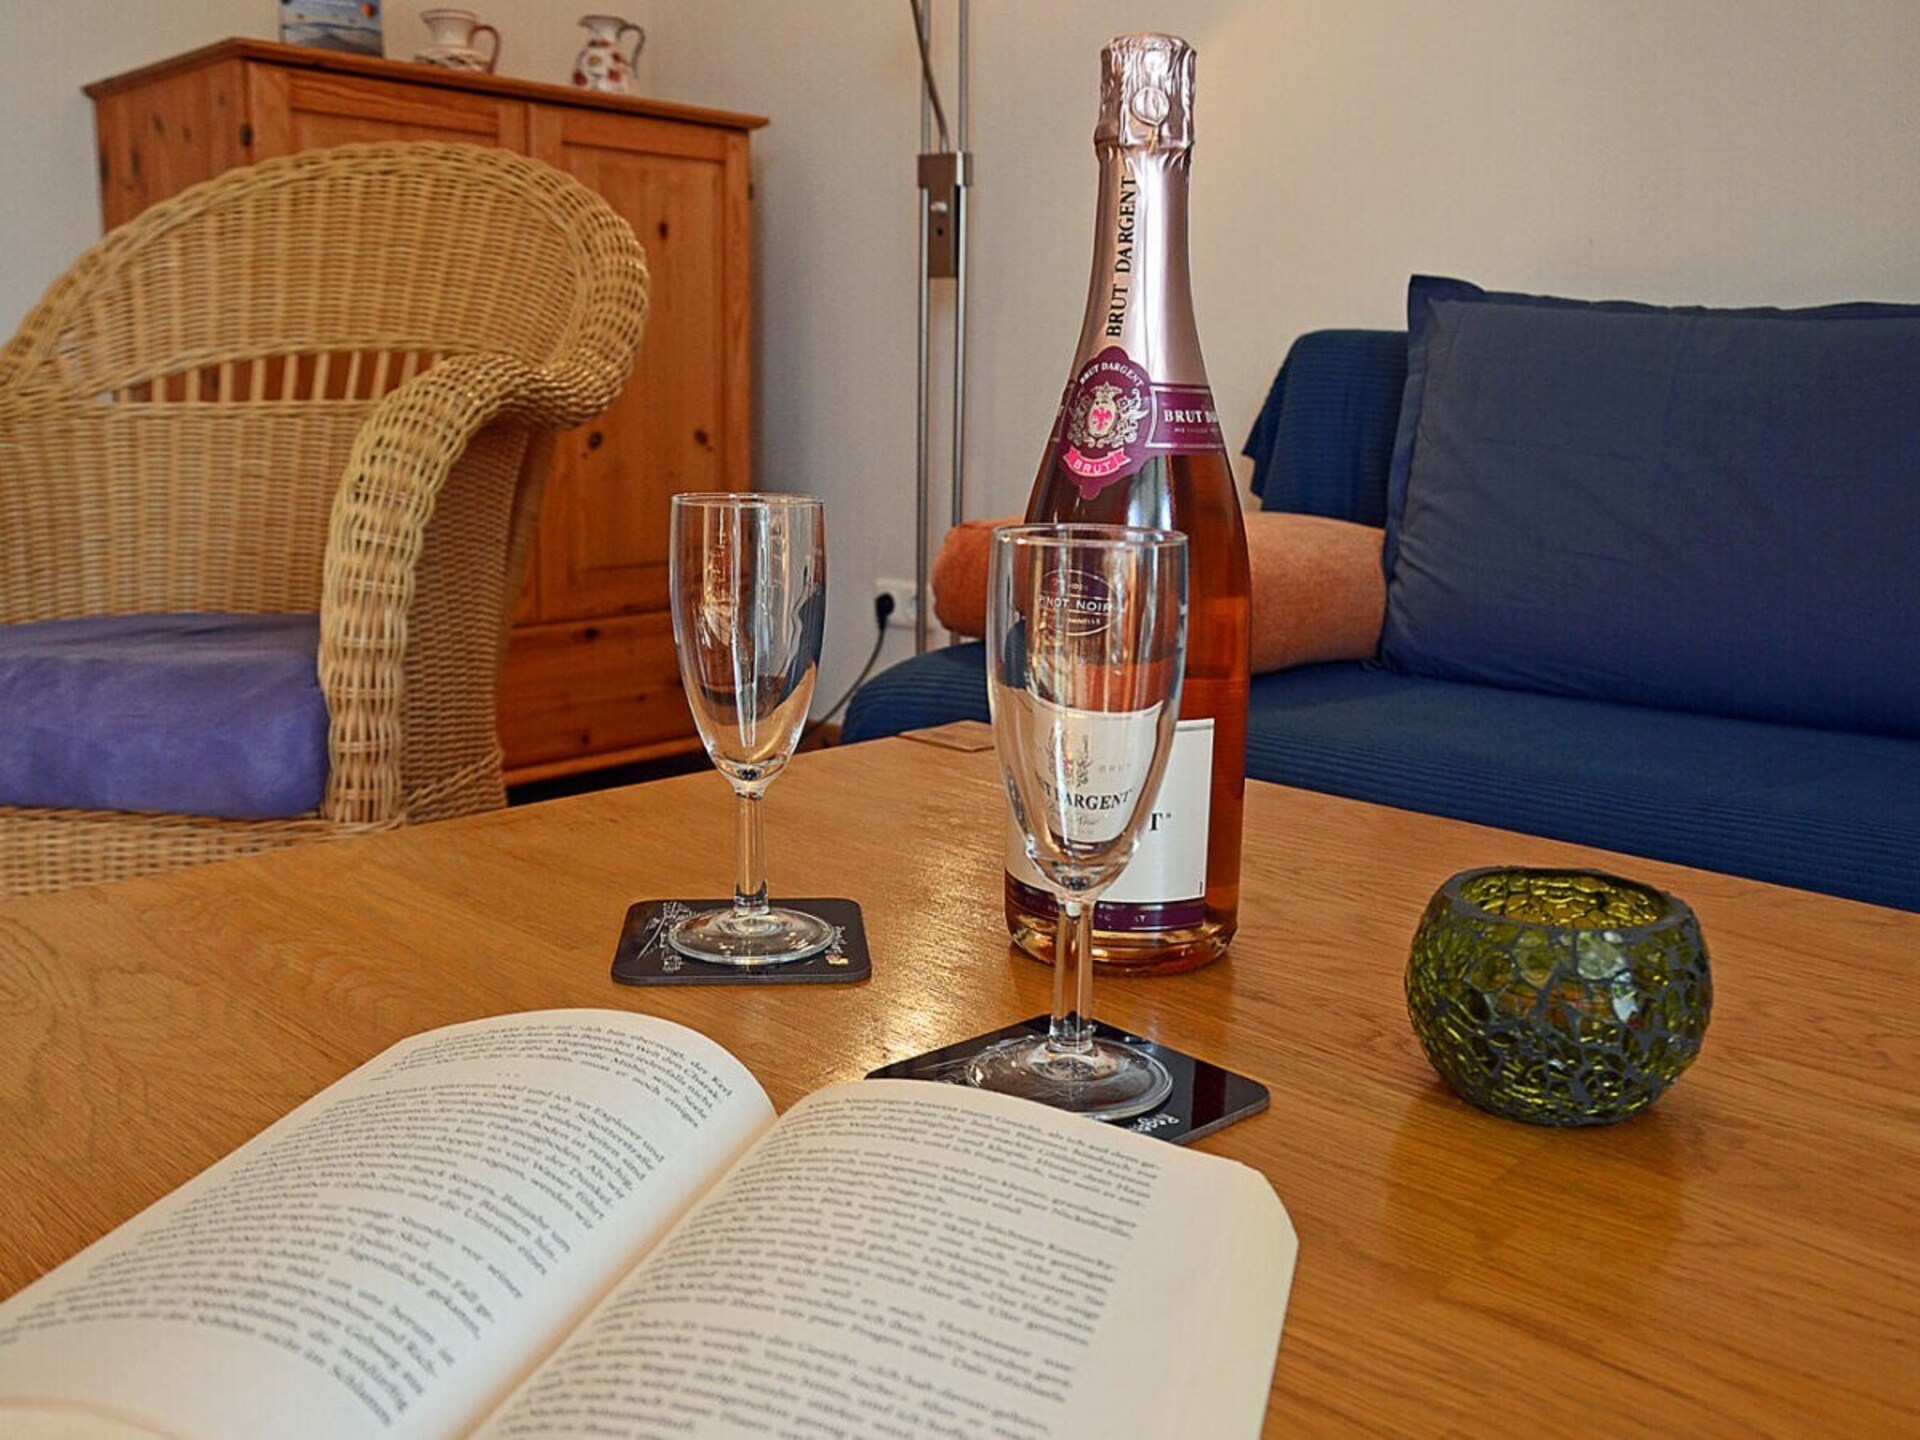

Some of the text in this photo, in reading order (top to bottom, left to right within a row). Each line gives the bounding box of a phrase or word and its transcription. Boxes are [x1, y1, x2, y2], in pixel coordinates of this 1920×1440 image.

[1106, 176, 1136, 337] BRUT DARGENT
[1079, 361, 1145, 388] BRUT DARGENT
[1164, 409, 1202, 423] BRUT
[1073, 459, 1112, 473] BRUT
[1076, 599, 1112, 612] NOIR
